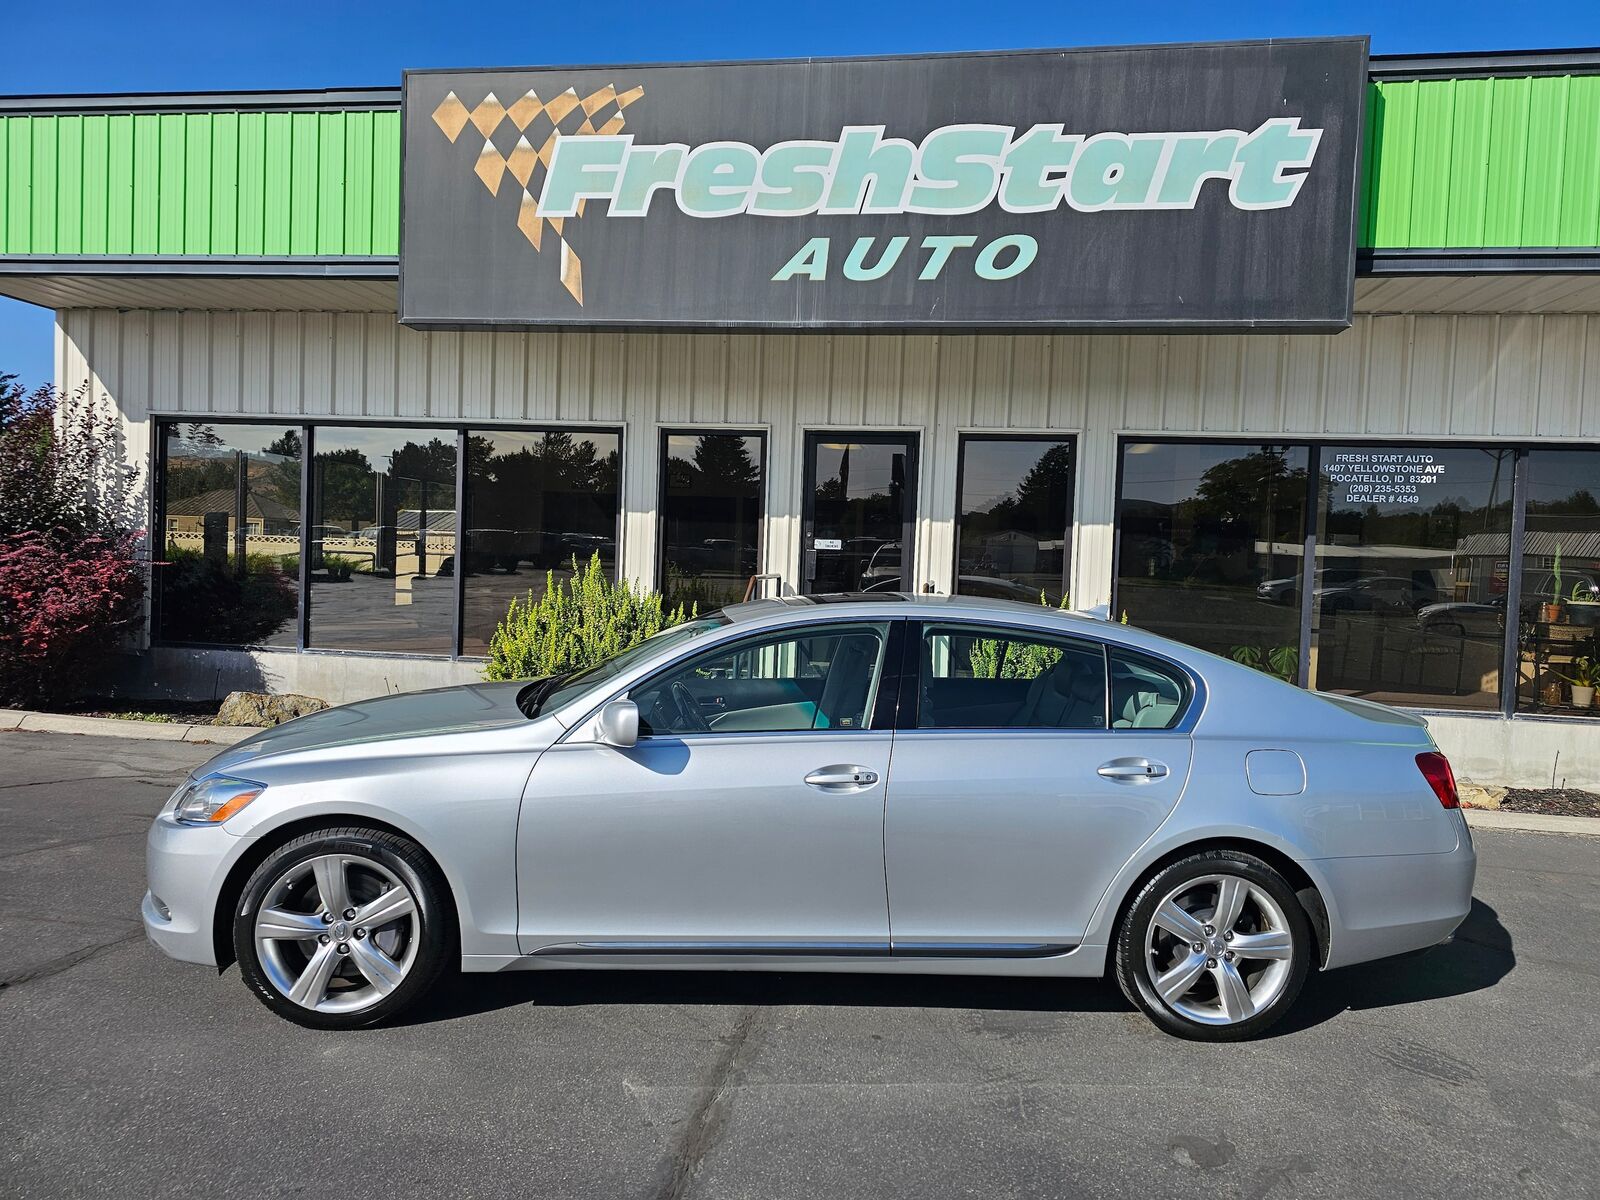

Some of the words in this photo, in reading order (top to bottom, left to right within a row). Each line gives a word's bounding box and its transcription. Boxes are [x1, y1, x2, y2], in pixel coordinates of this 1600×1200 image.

[535, 117, 1324, 219] FreshStart
[770, 234, 1039, 281] AUTO
[1336, 454, 1369, 463] FRESH
[1371, 454, 1404, 463] START
[1405, 455, 1433, 463] AUTO
[1324, 464, 1345, 472] 1407
[1348, 464, 1423, 473] YELLOWSTONE
[1424, 465, 1445, 474] AVE
[1330, 474, 1392, 484] POCATELLO,
[1394, 475, 1404, 483] ID
[1409, 475, 1437, 483] 83201
[1349, 484, 1373, 494] (208)
[1374, 485, 1416, 493] 235-5353
[1346, 494, 1386, 503] DEALER
[1388, 495, 1395, 503] #
[1396, 495, 1419, 503] 4549
